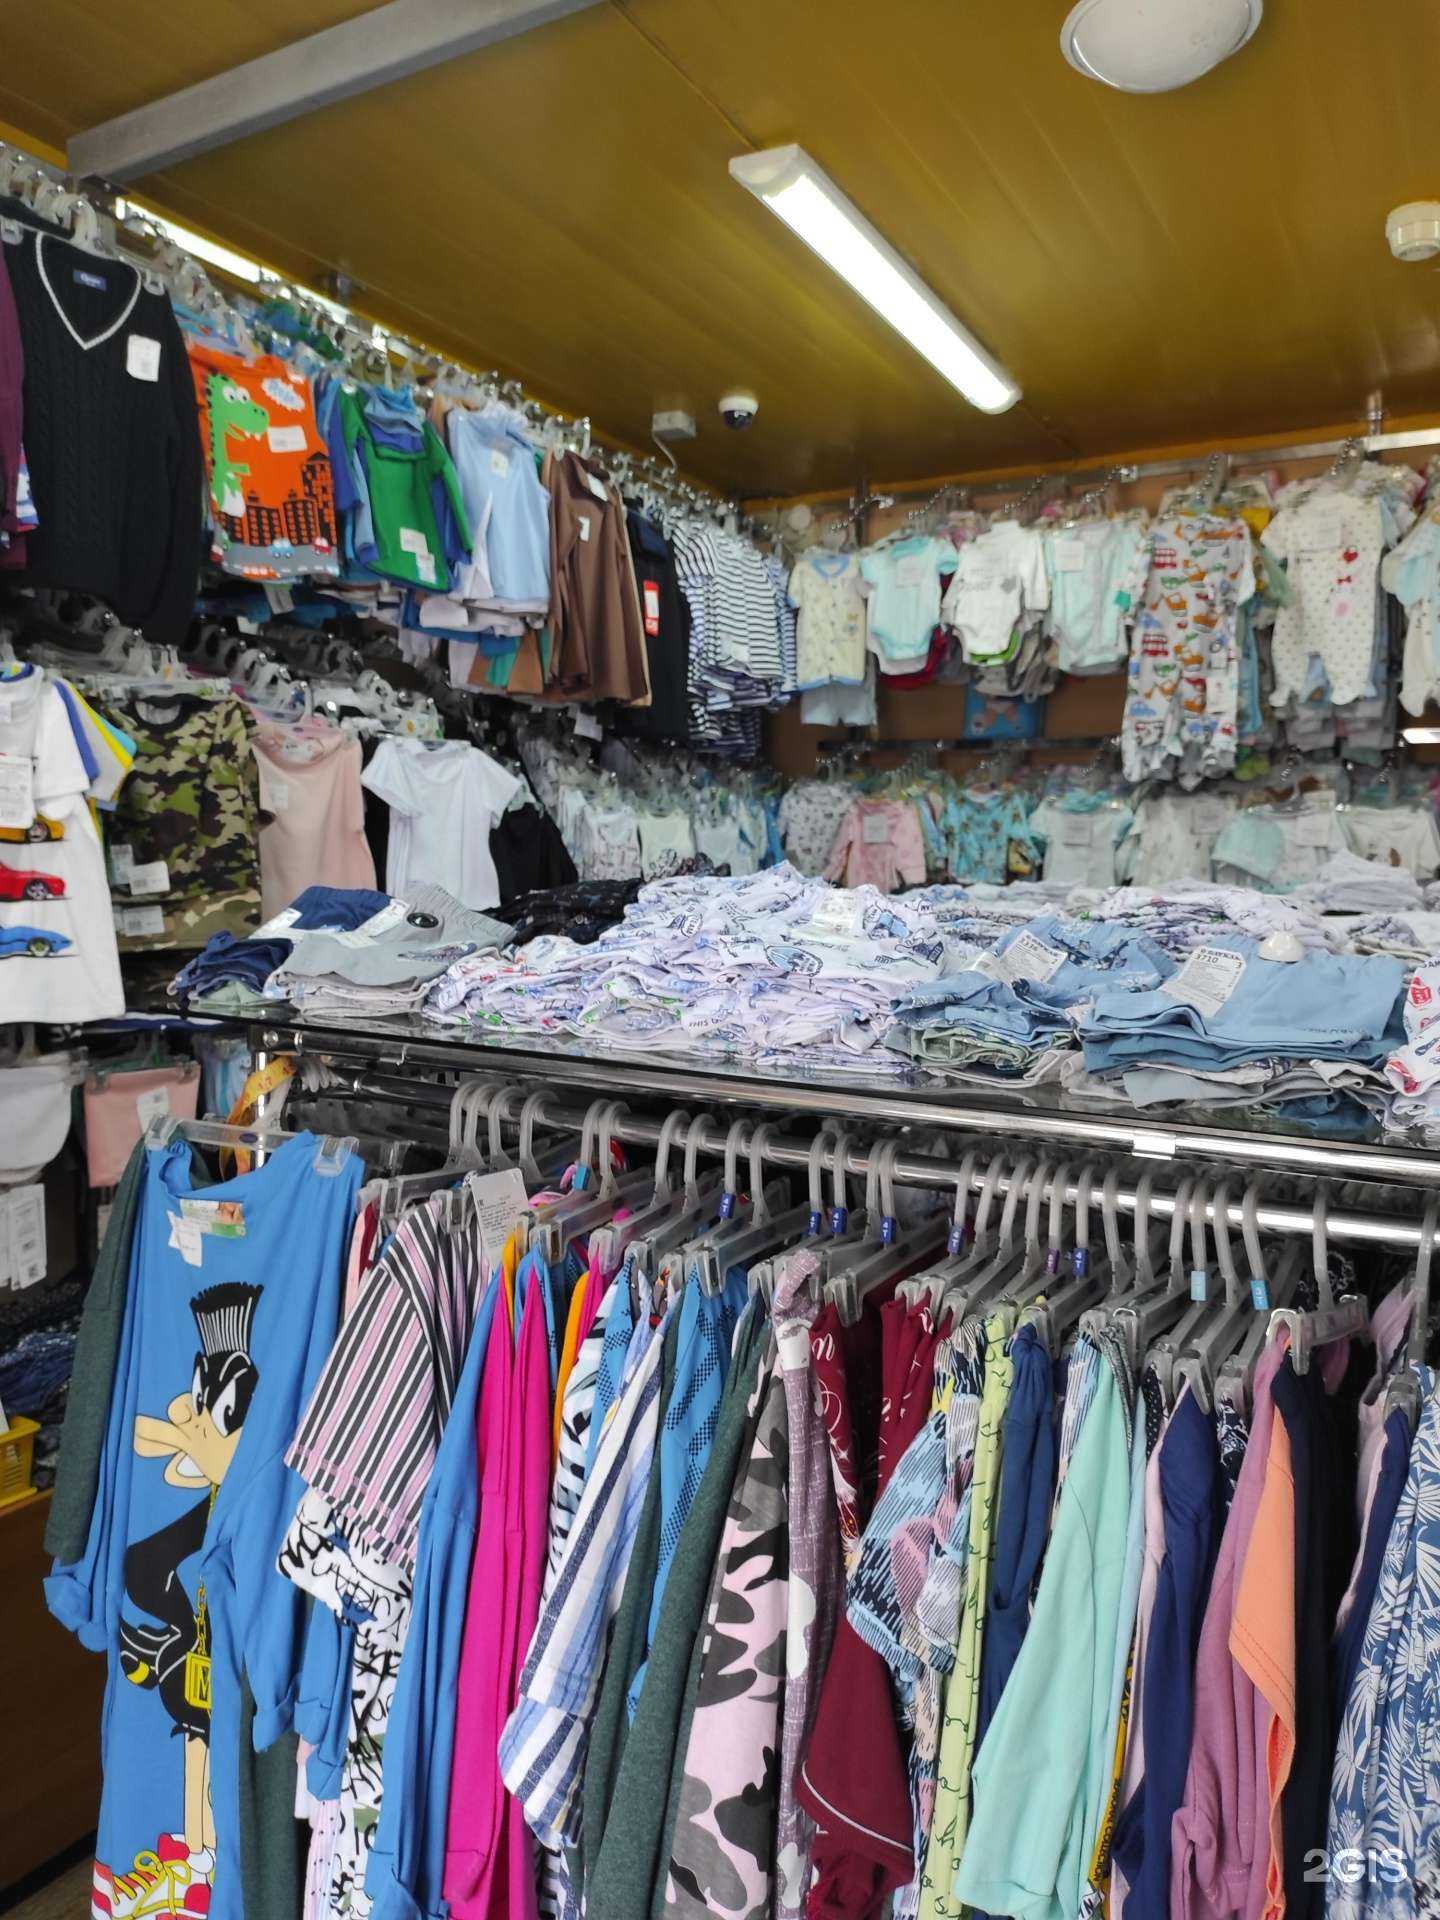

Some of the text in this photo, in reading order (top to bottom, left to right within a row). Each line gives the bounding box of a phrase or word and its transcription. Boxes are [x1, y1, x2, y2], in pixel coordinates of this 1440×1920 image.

[832, 1212, 839, 1228] 4T
[882, 1221, 888, 1238] 4T
[1075, 1251, 1082, 1268] 4T
